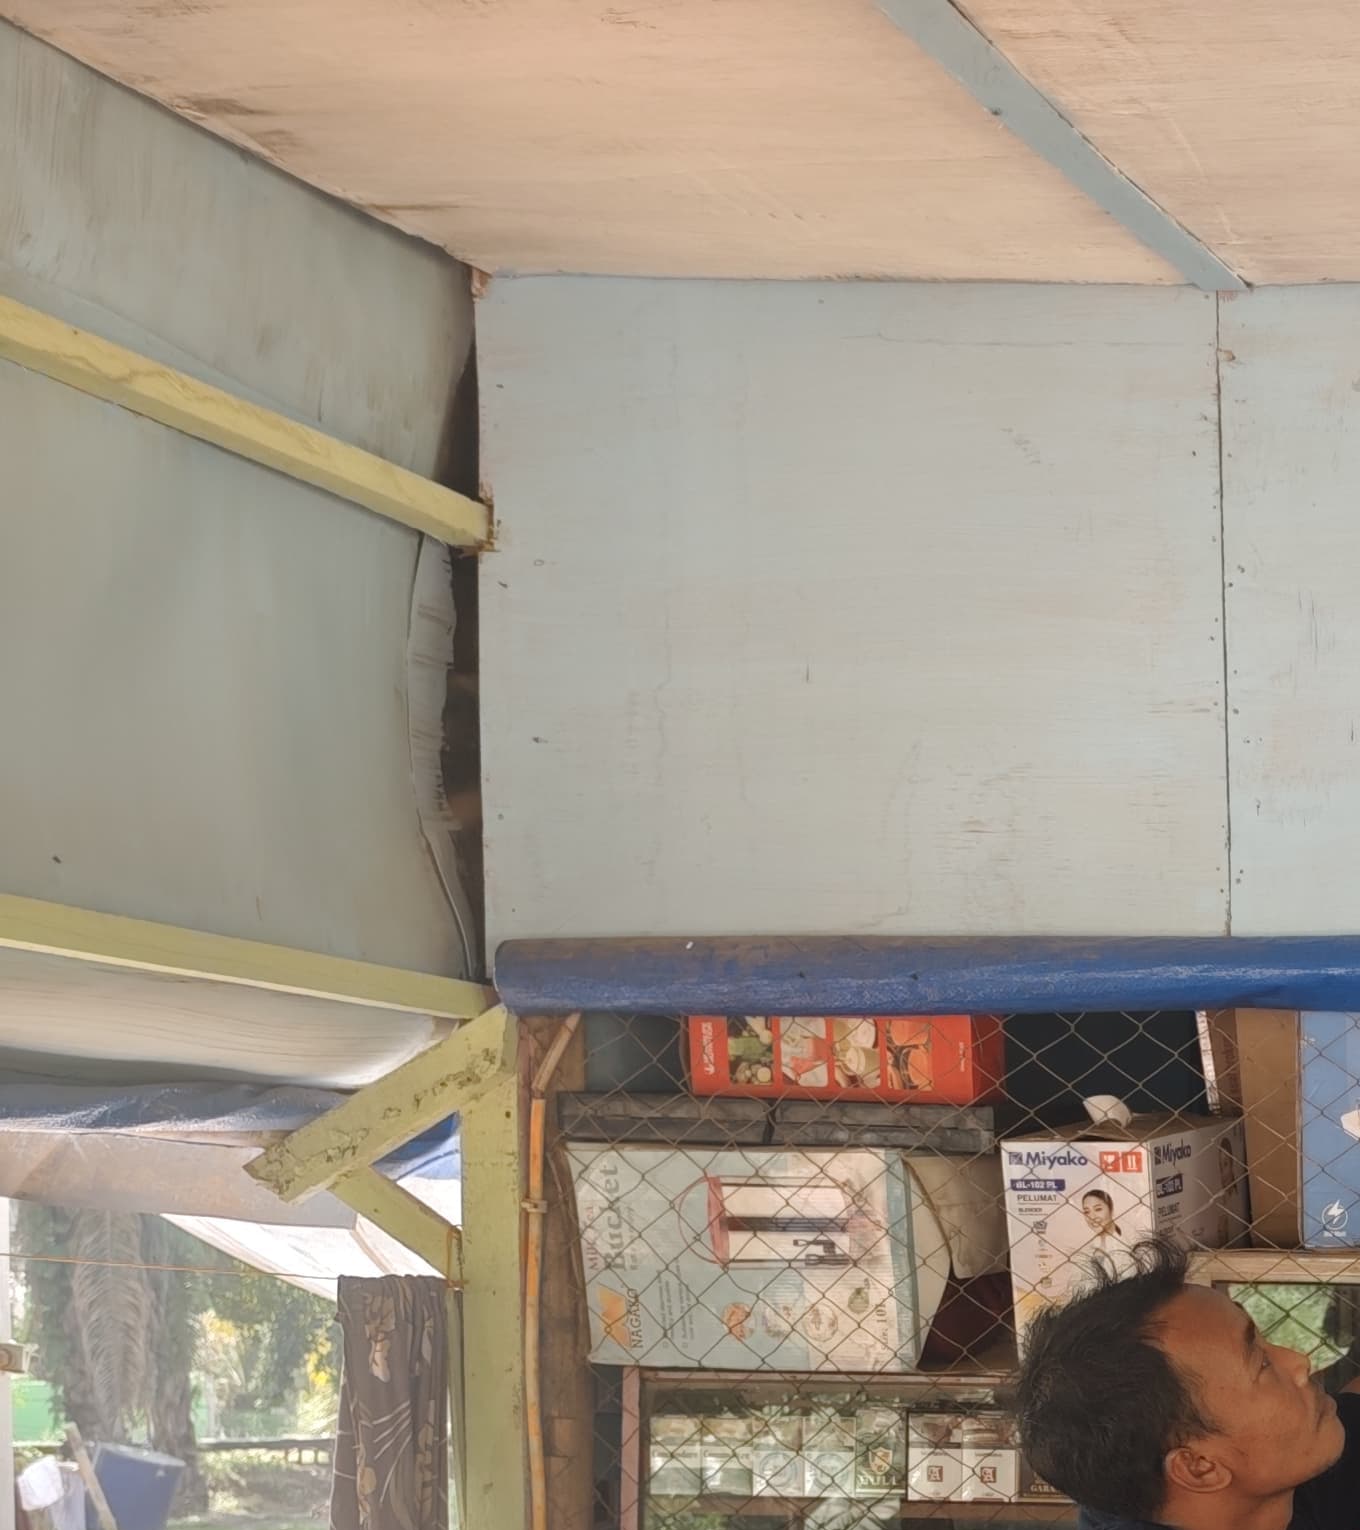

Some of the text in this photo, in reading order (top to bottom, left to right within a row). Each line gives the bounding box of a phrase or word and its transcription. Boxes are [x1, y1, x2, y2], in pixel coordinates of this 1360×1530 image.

[1026, 1151, 1088, 1169] Miyako
[1162, 1143, 1191, 1166] Miyako
[627, 1288, 643, 1349] NAGAKO
